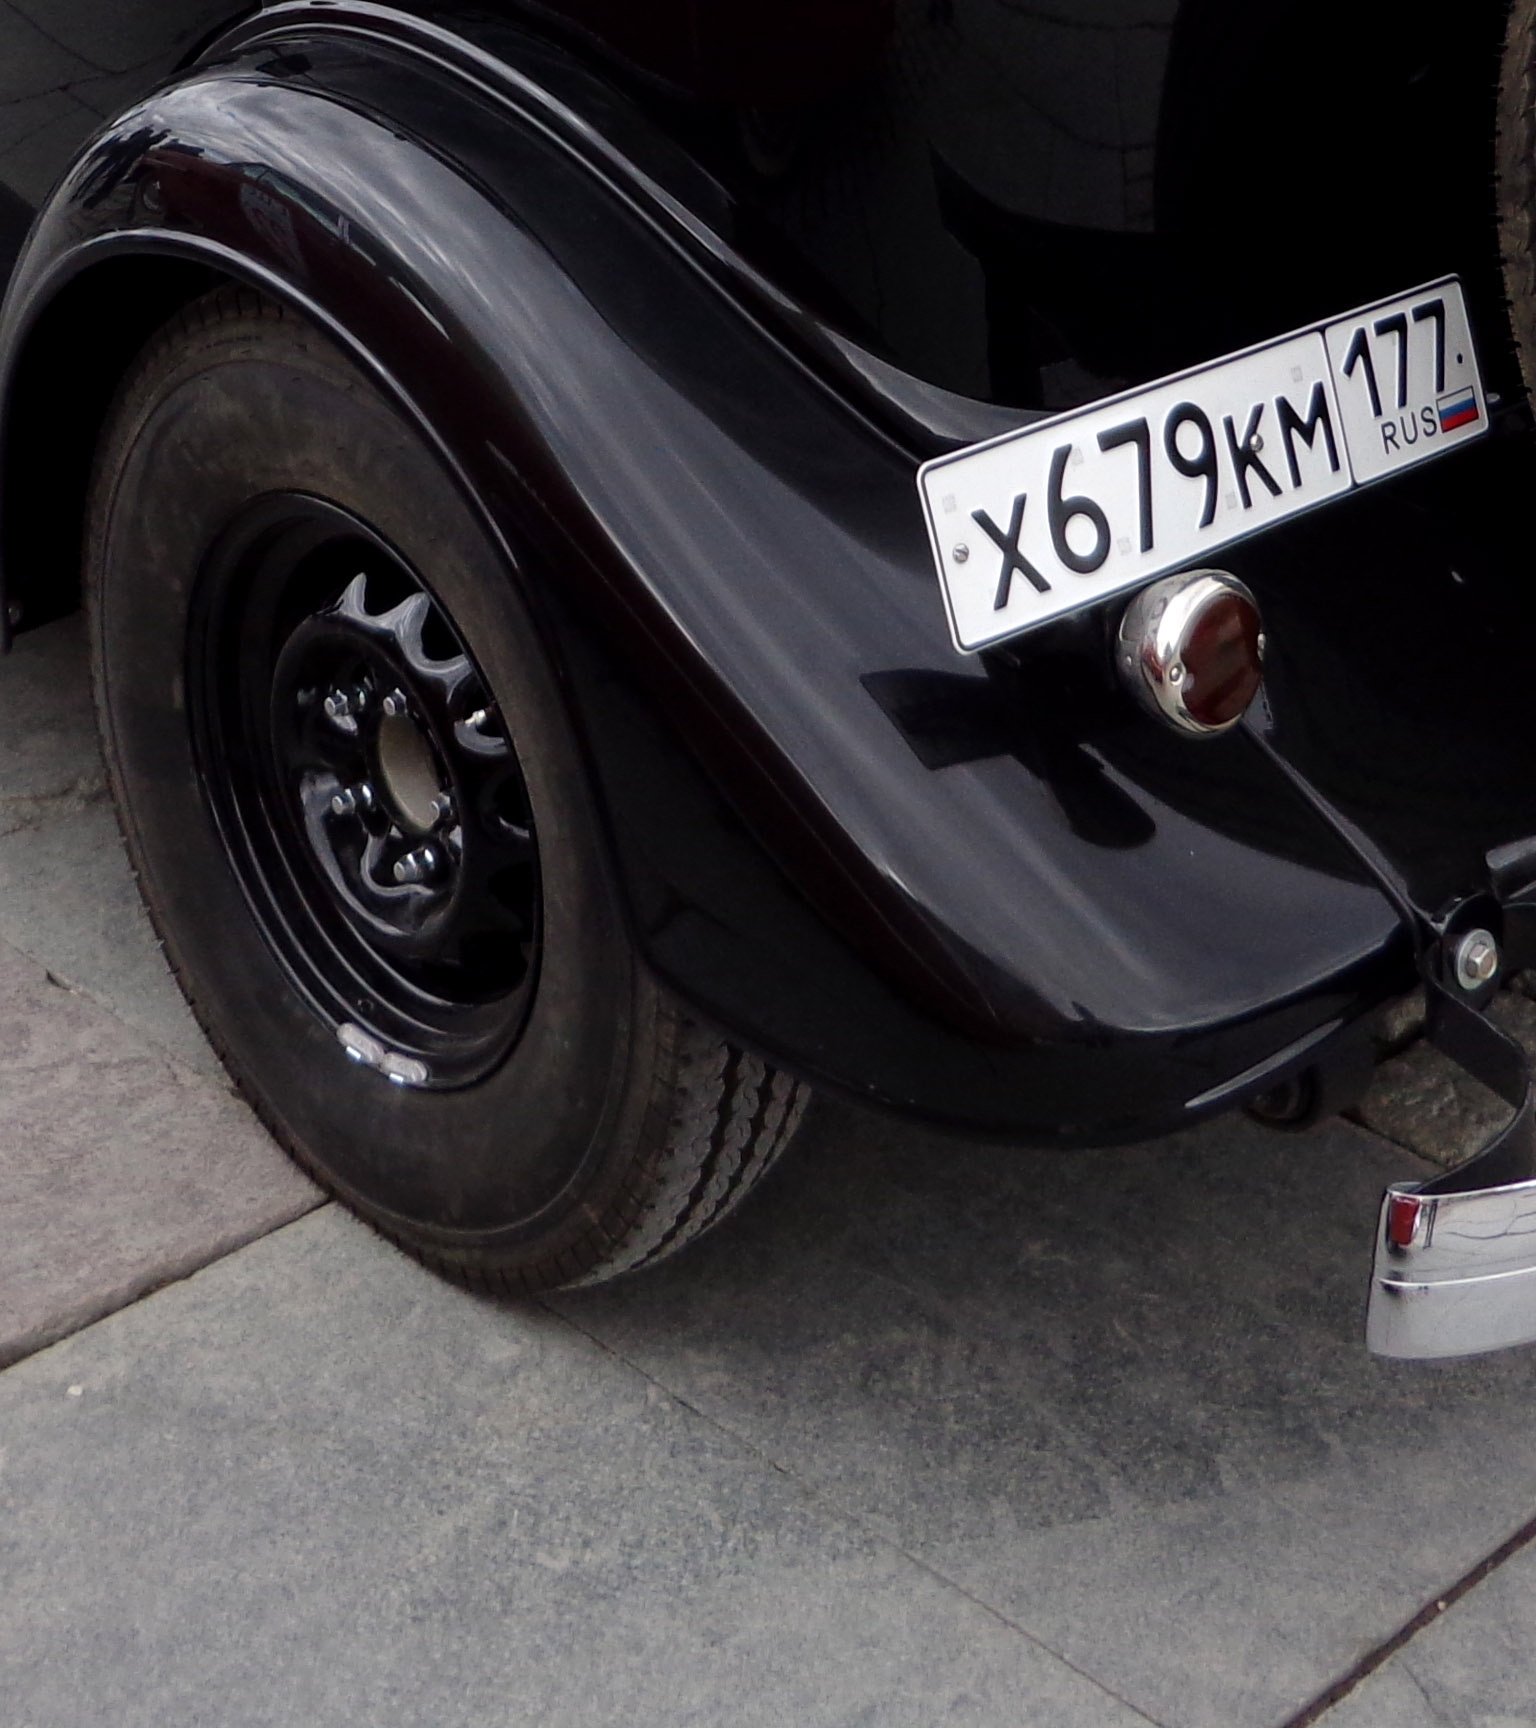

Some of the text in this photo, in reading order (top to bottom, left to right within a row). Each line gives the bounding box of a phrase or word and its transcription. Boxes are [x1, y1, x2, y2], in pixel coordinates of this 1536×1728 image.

[970, 298, 1446, 611] Х679КМ 177
[1382, 405, 1438, 455] RUS
